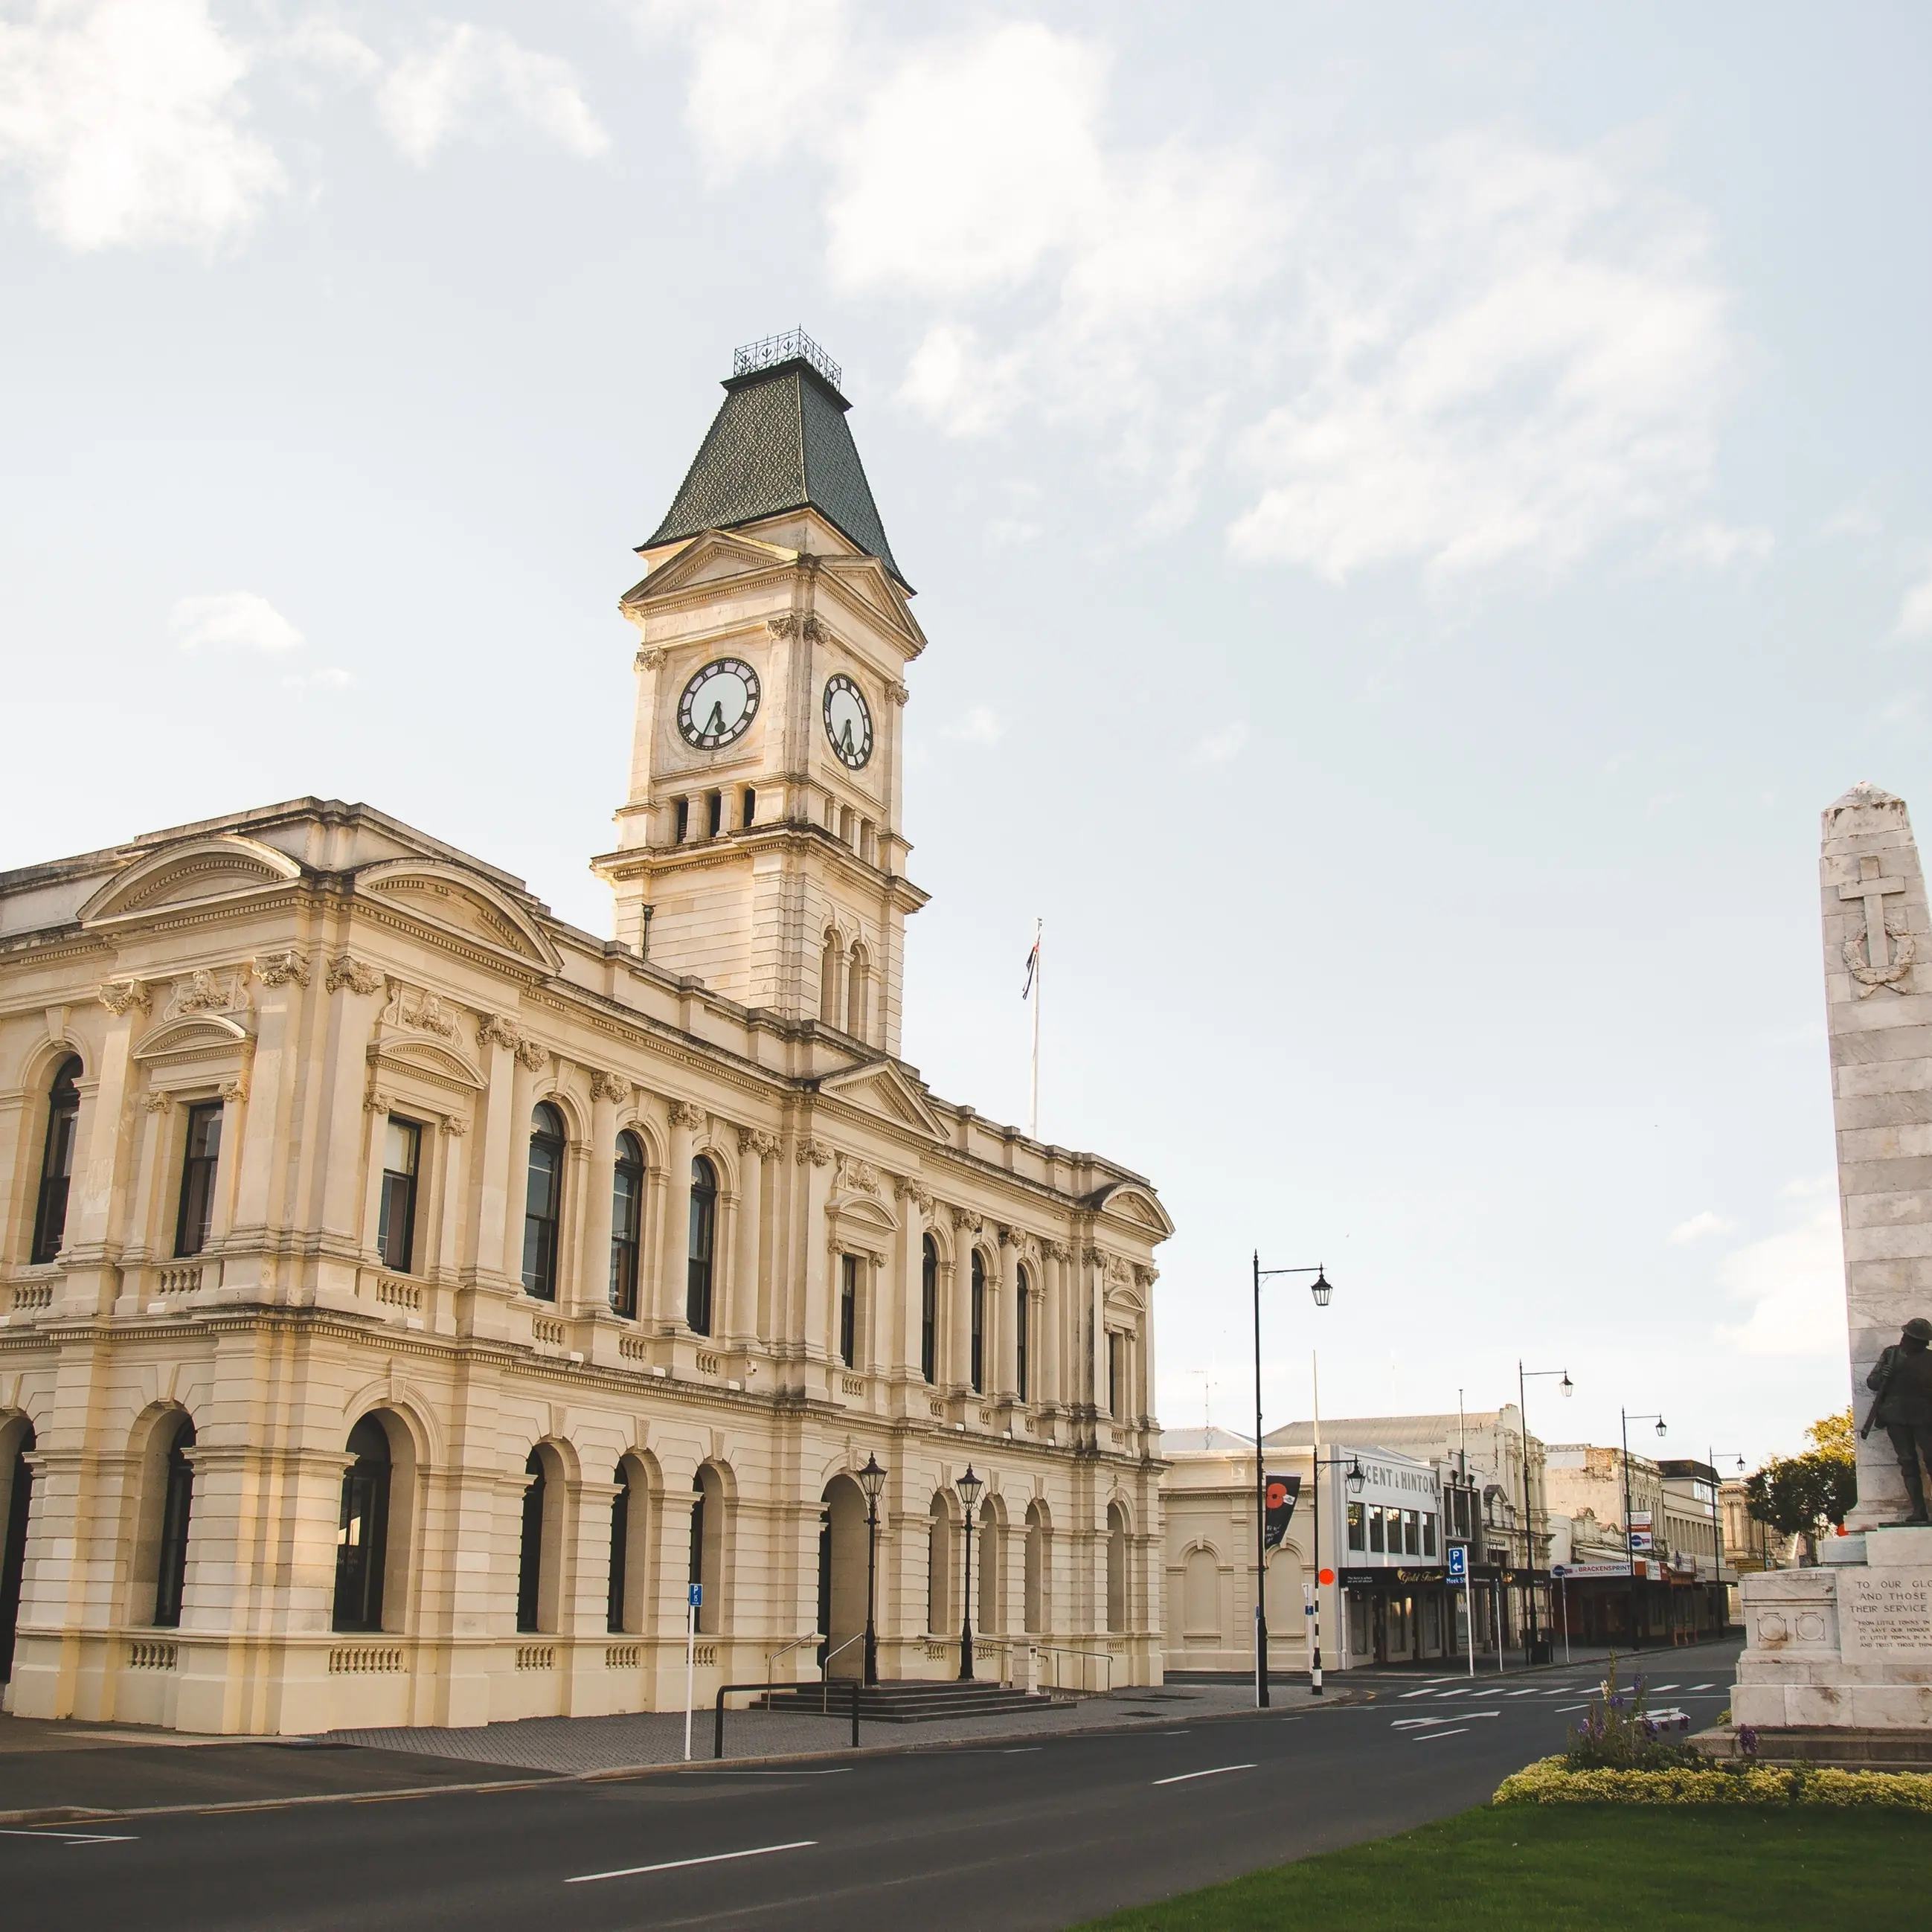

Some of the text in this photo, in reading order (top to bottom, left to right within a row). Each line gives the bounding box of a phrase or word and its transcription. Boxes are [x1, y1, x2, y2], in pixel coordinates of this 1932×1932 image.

[1346, 1462, 1393, 1487] VNCENT
[1401, 1472, 1434, 1494] HINTON
[1453, 1551, 1460, 1560] P
[1881, 1580, 1901, 1588] OUR
[694, 1585, 699, 1594] P
[1889, 1592, 1927, 1600] THOSE
